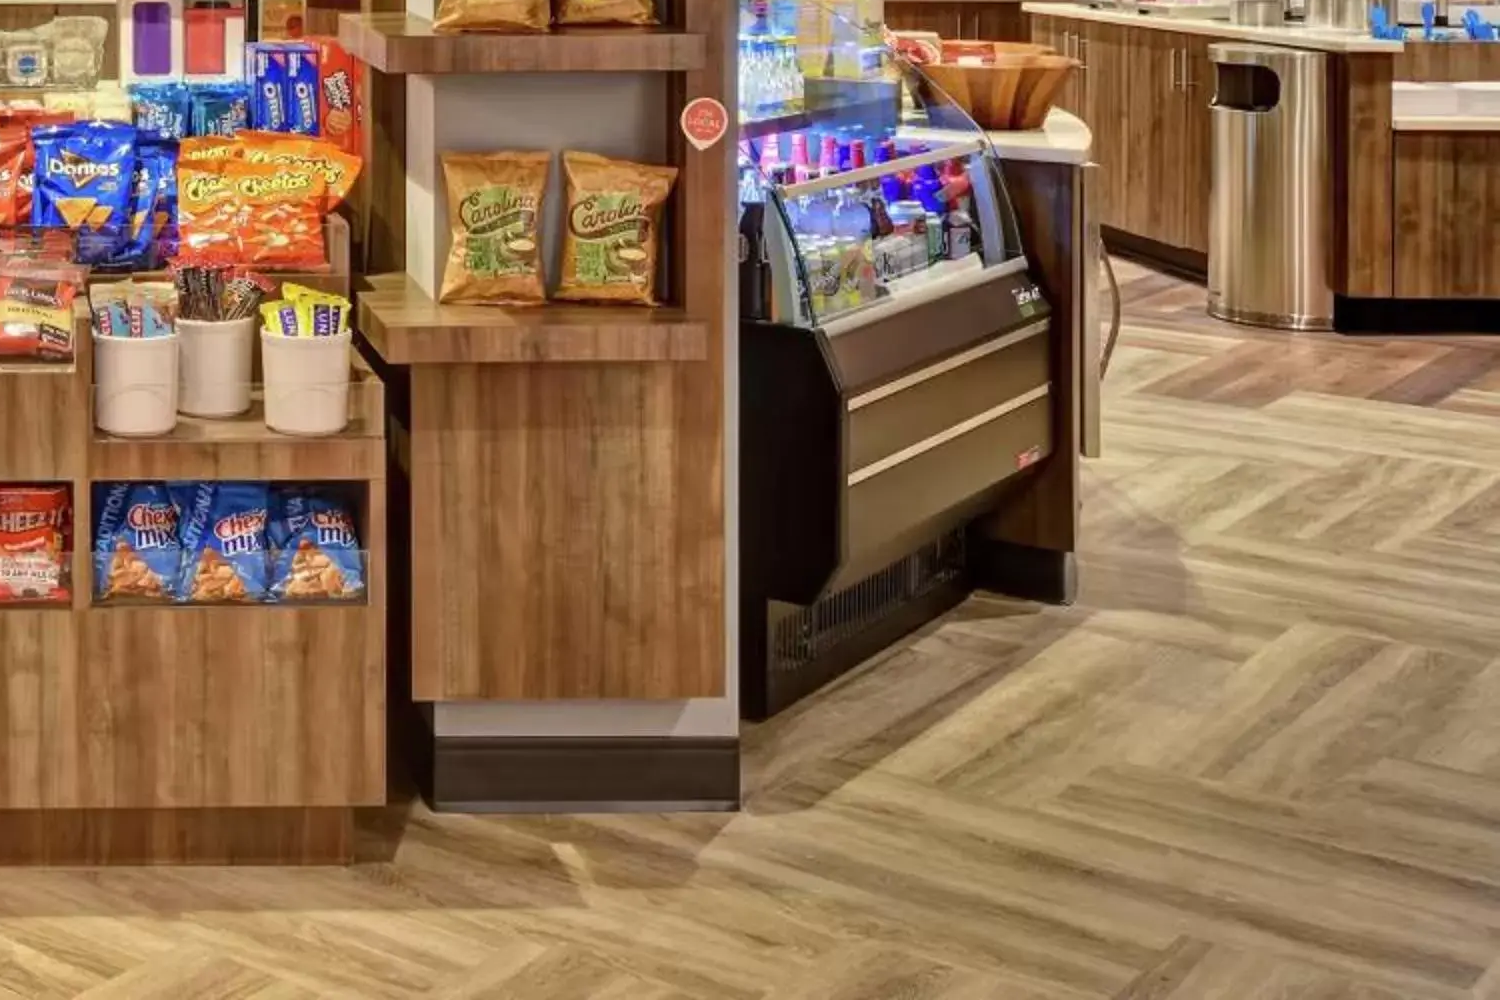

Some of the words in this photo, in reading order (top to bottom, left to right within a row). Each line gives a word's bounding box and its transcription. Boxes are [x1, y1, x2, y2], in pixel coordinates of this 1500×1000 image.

[50, 157, 120, 181] Doritos
[236, 171, 312, 197] Cheetos
[127, 502, 179, 532] Chex
[213, 509, 267, 540] Chex
